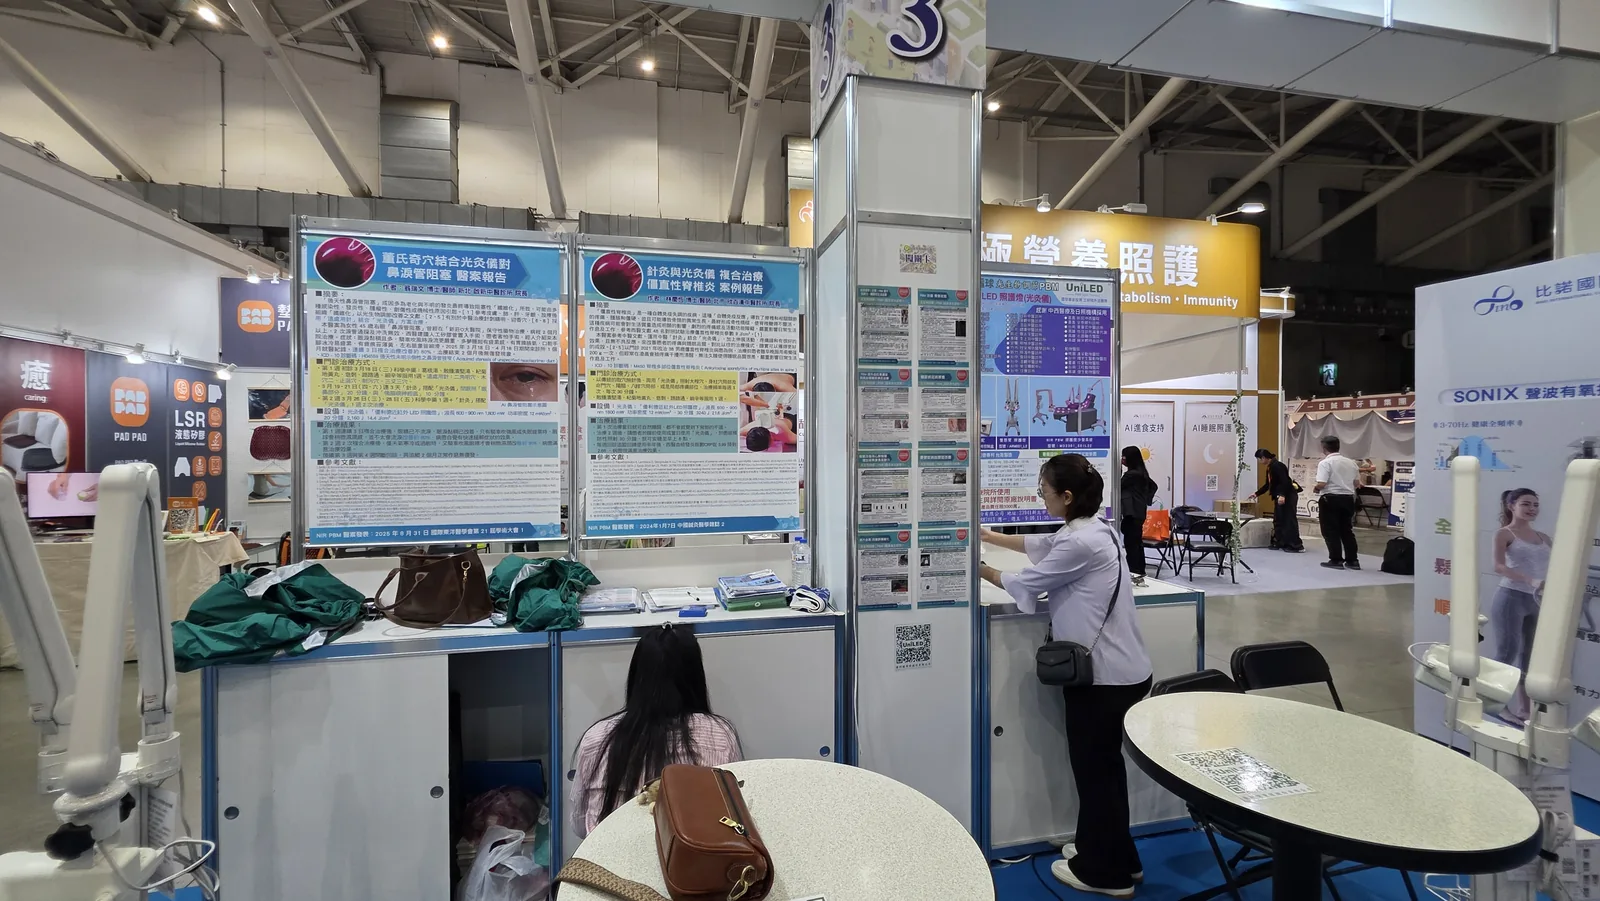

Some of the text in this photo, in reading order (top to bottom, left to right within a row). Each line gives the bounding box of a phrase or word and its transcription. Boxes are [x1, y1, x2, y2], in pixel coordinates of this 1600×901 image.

[886, 0, 943, 58] 3
[382, 252, 512, 271] 董氏奇穴結合光灸儀對
[386, 266, 506, 284] 鼻淚管阻塞 醫案報告
[647, 266, 763, 282] 針灸與光灸儀 複合治療
[647, 280, 763, 294] 僵直性脊椎炎 案例報告
[1066, 282, 1103, 293] UniLED
[1536, 276, 1600, 298] 比諾國
[1184, 294, 1238, 309] Immunity
[20, 359, 52, 391] 癒
[24, 394, 47, 403] caring
[1454, 387, 1519, 403] SONIX
[175, 410, 205, 428] LSR
[175, 430, 205, 440] 液態矽膠
[1125, 424, 1165, 432] AI進食支持
[1192, 424, 1232, 432] AI睡眠照護
[114, 432, 147, 442] PAD PAD
[1435, 518, 1452, 535] 全
